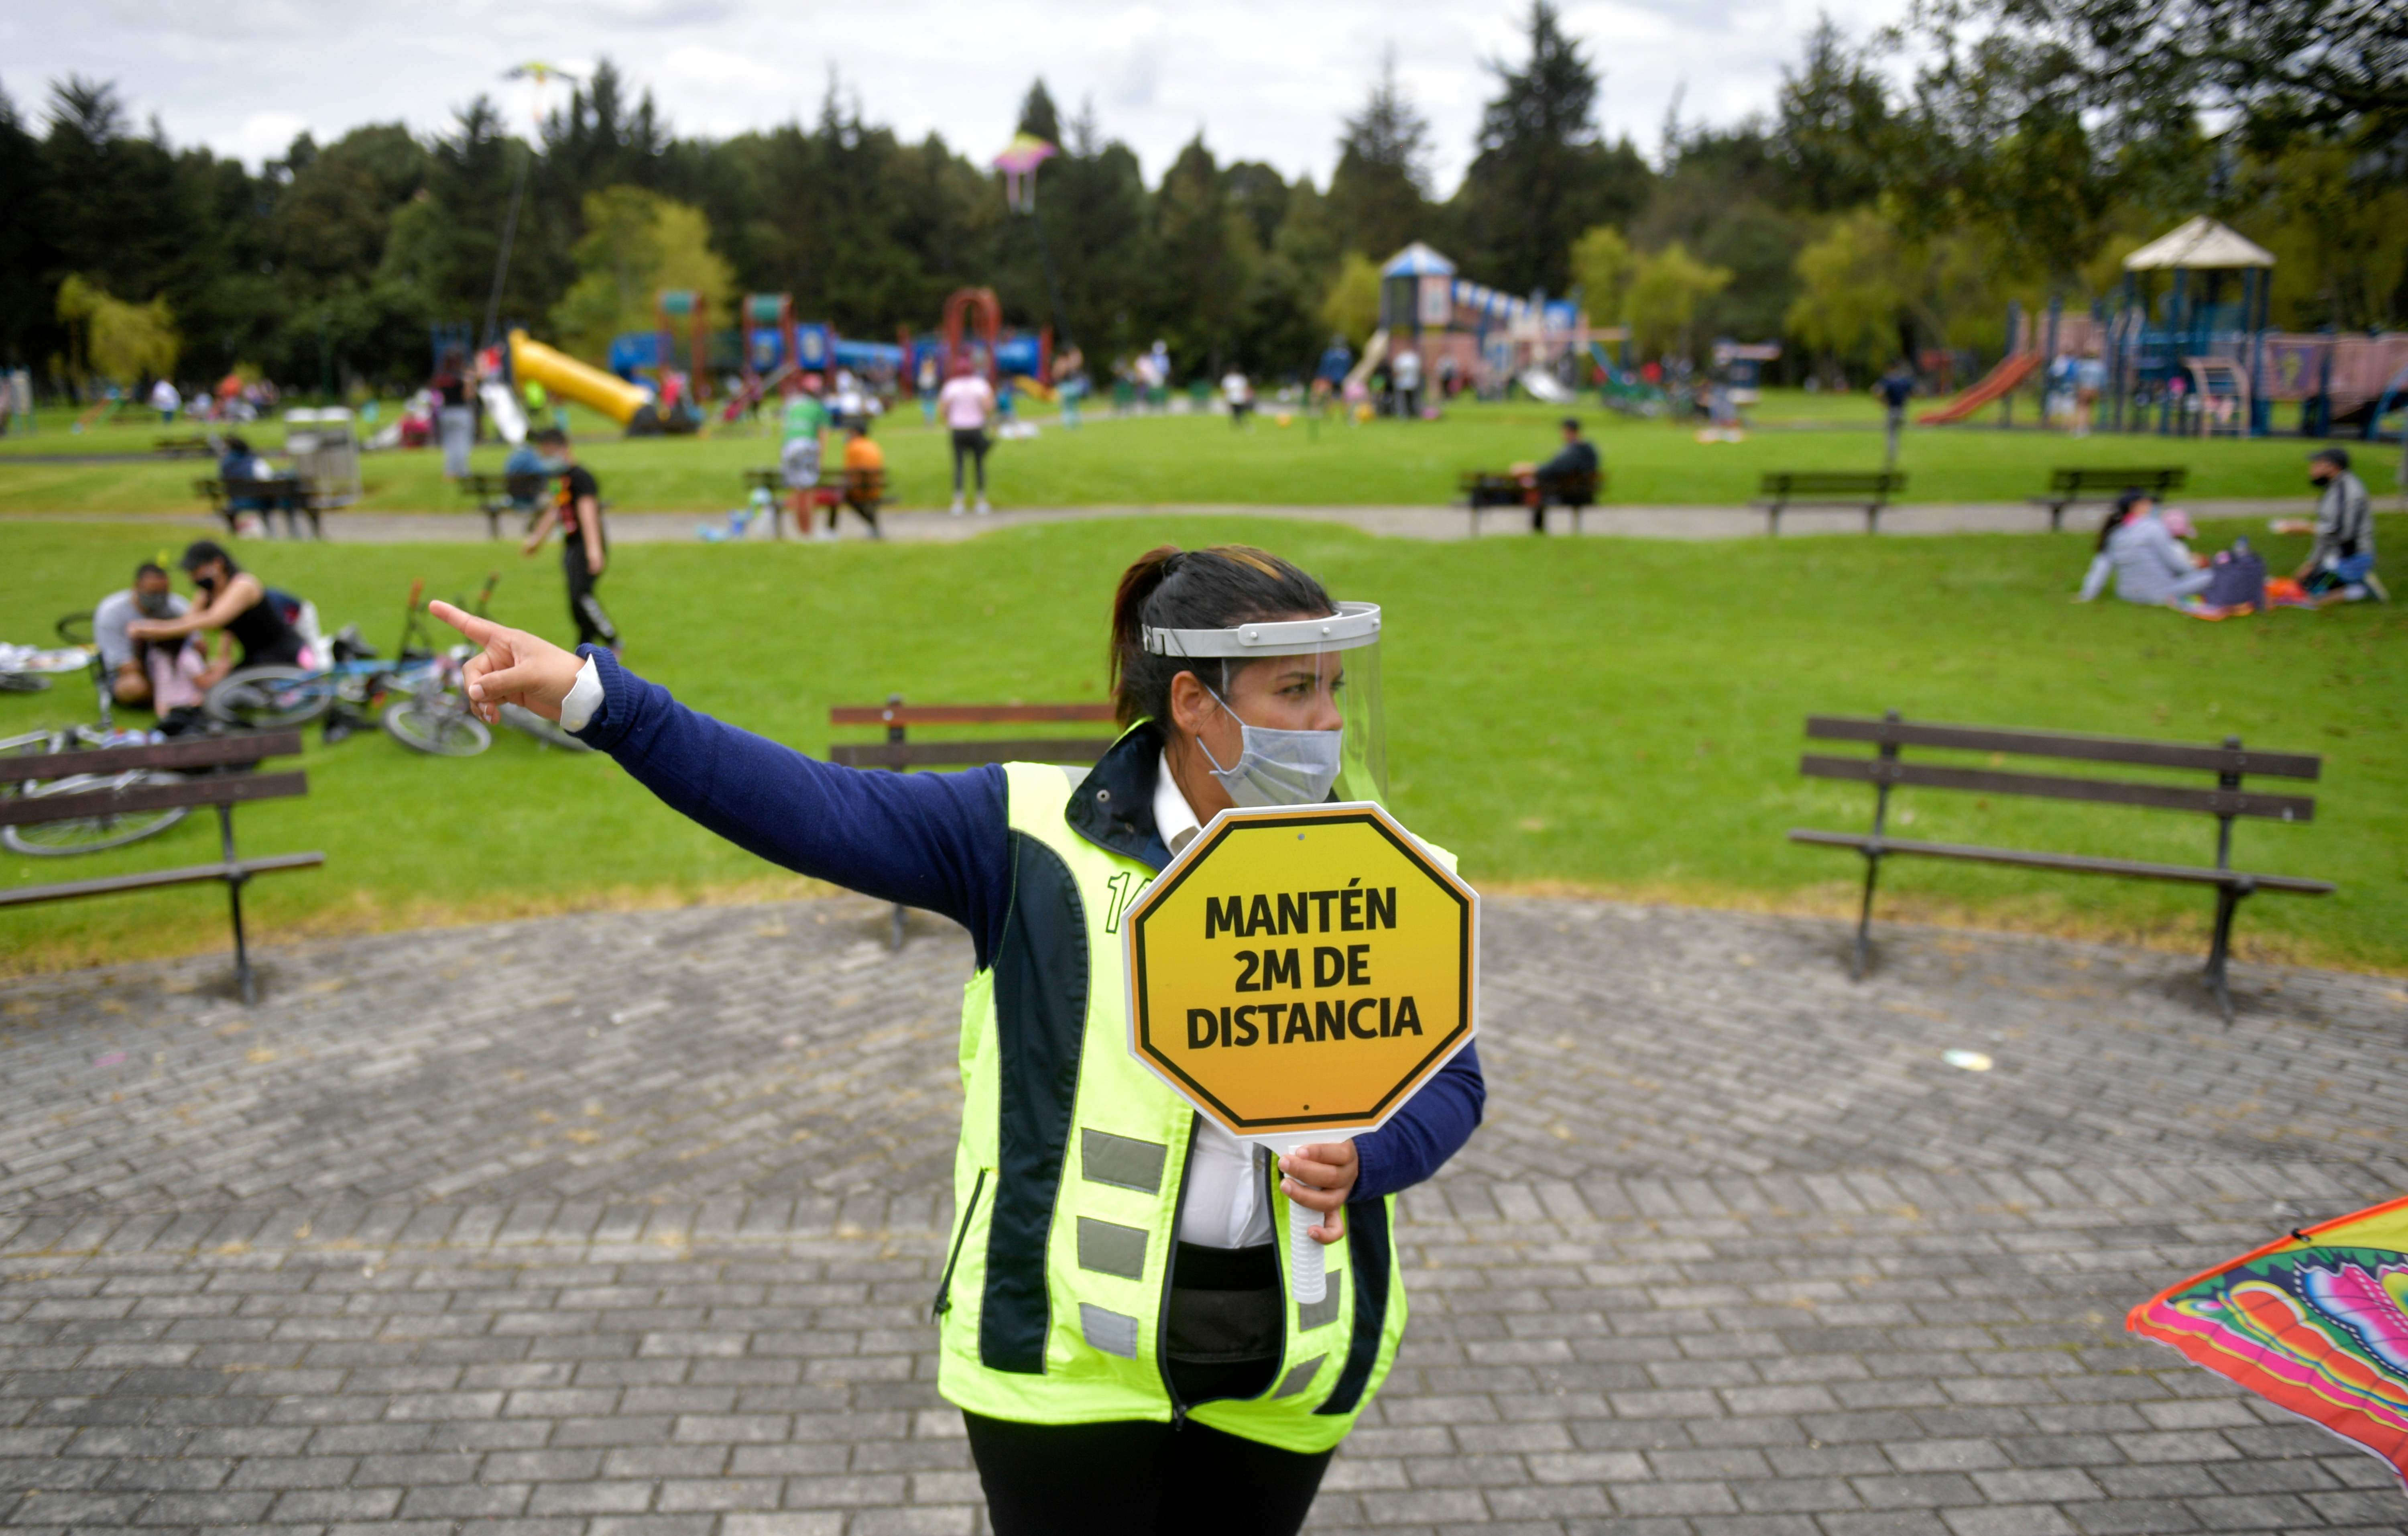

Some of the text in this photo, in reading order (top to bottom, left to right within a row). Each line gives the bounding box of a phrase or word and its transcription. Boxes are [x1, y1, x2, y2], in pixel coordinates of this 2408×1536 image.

[1205, 877, 1396, 939] MANTÉN
[1233, 944, 1371, 993] 2M DE
[1186, 996, 1424, 1050] DISTANCIA
